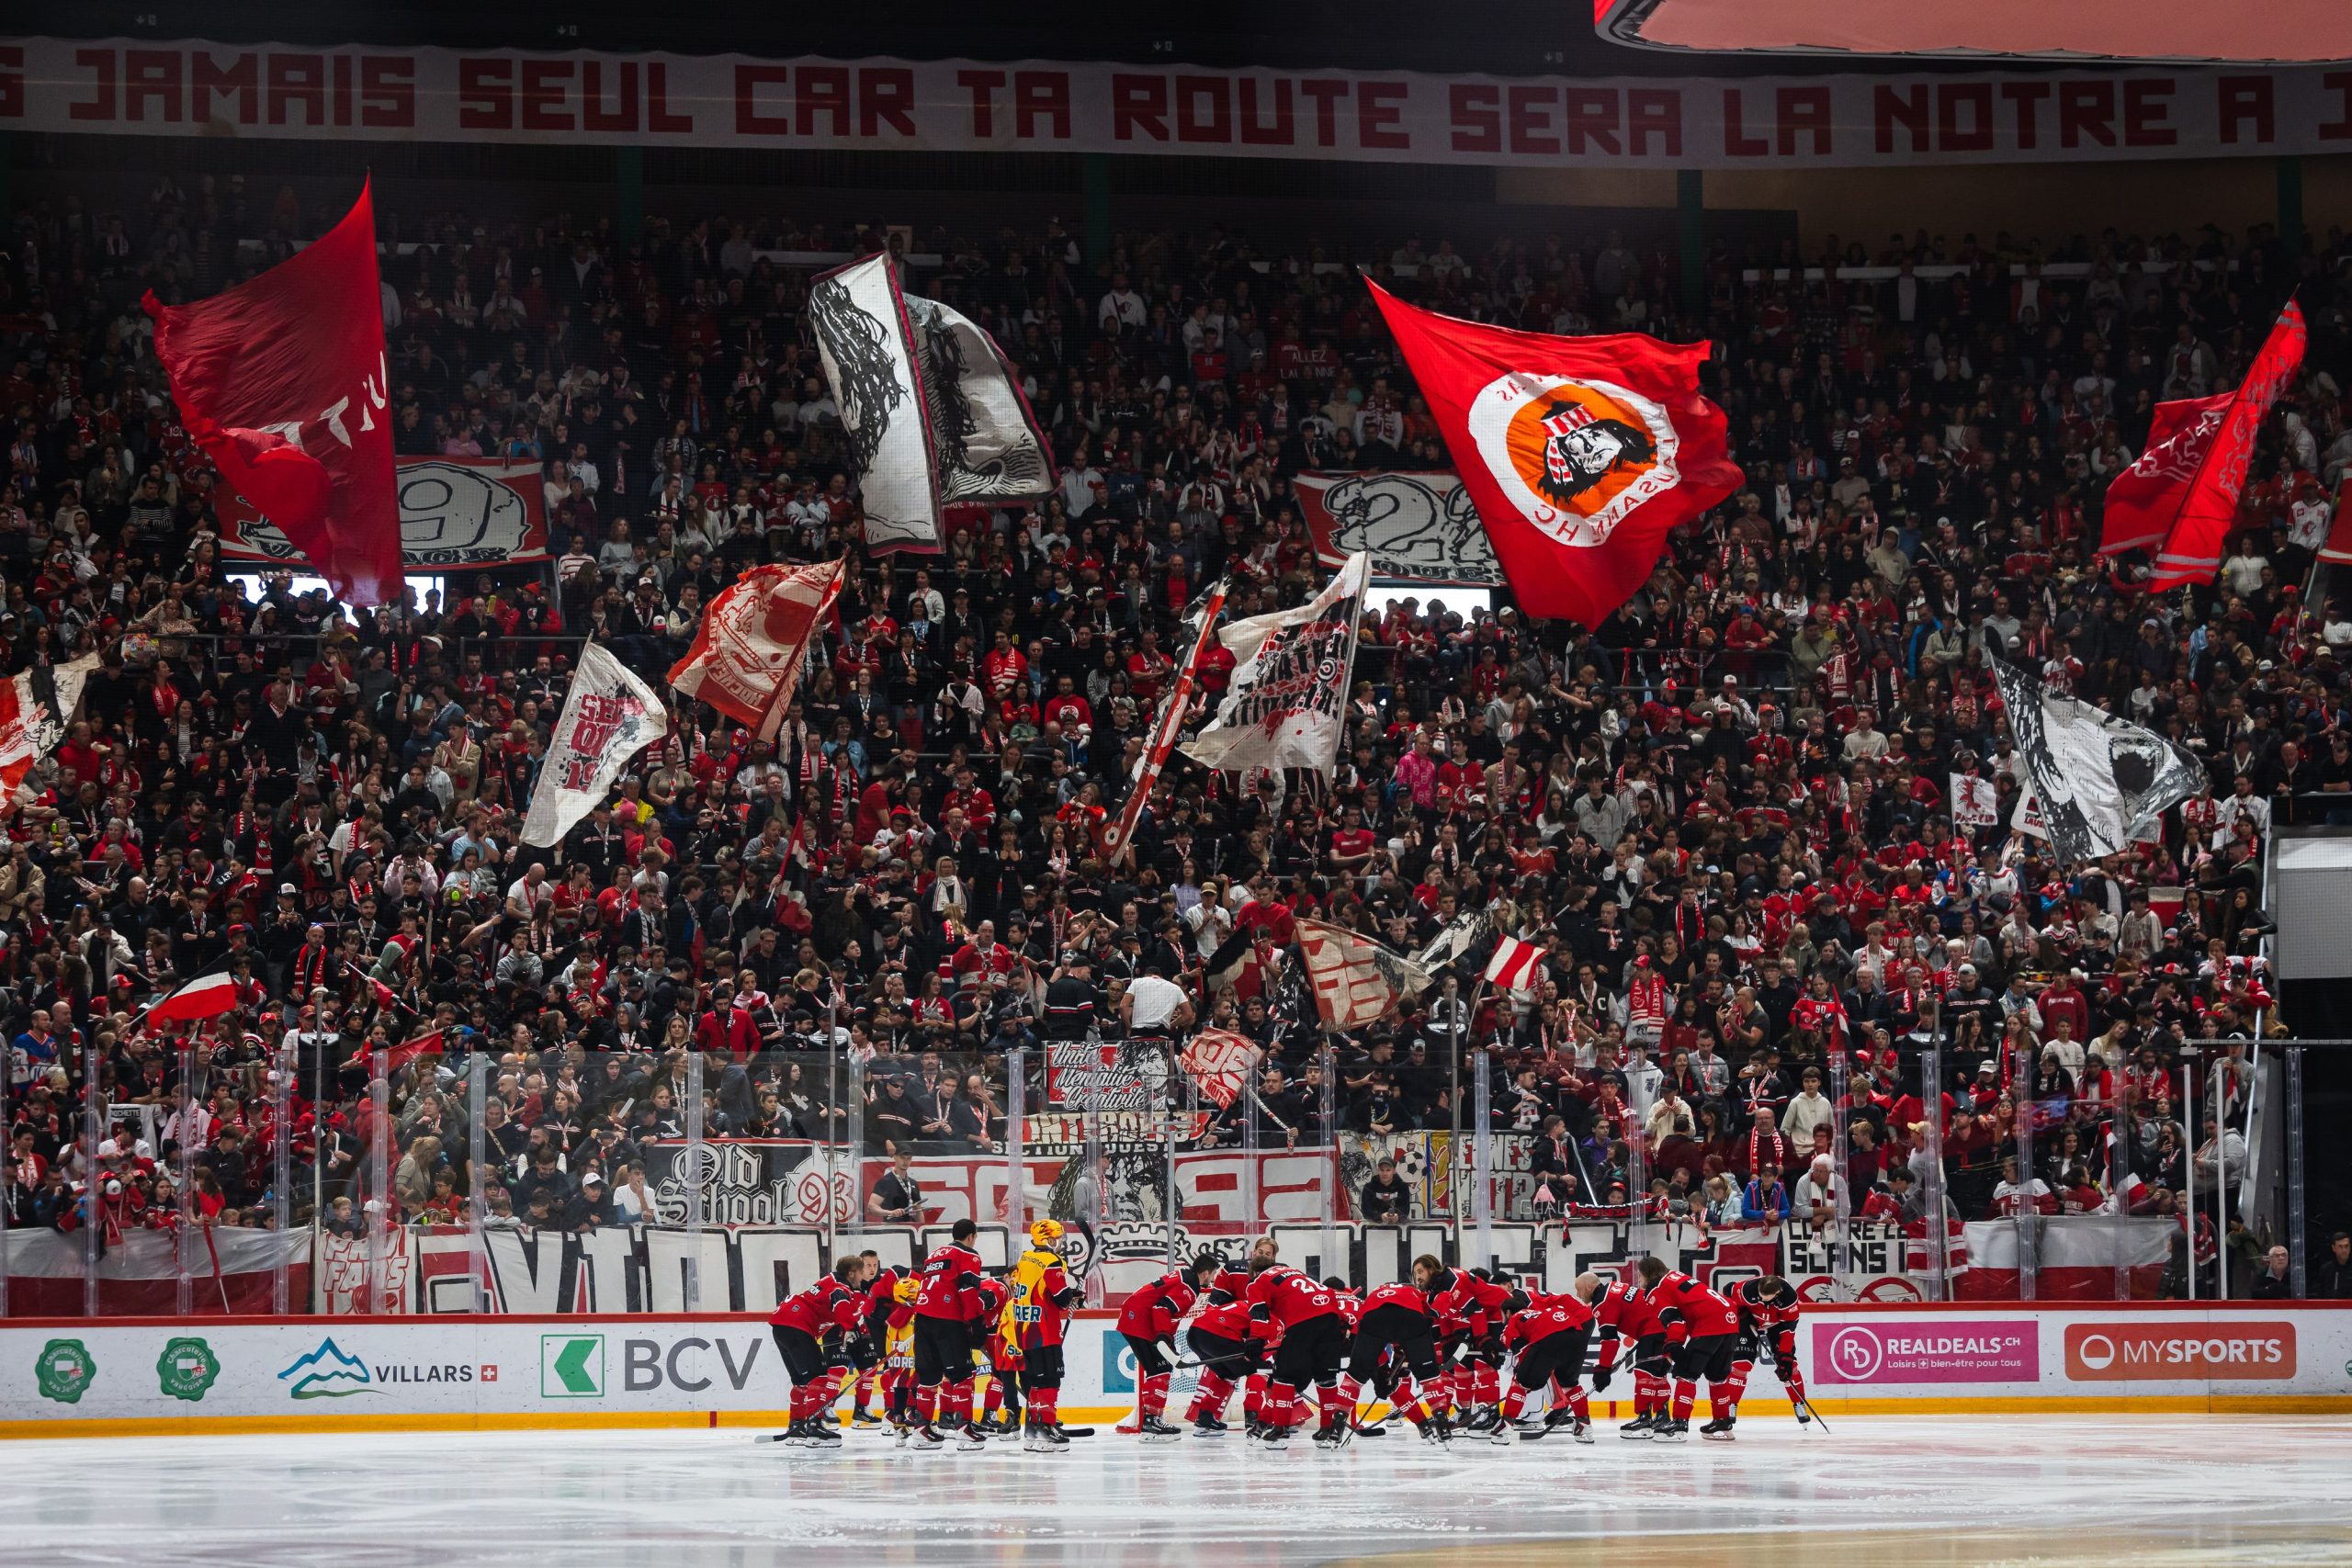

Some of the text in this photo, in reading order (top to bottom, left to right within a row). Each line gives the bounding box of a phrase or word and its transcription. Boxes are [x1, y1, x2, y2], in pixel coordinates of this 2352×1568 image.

[70, 49, 414, 127] JAMAIS
[459, 58, 693, 133] SEUL
[735, 64, 915, 137] CAR
[957, 70, 1070, 139] TA
[1113, 73, 1409, 149] ROUTE
[1450, 83, 1682, 157] SERA
[1724, 87, 1832, 157] LA
[1874, 78, 2177, 154] NOTRE
[2218, 75, 2275, 144] A
[1293, 350, 1327, 363] ALLEZ
[716, 765, 727, 776] 24
[1597, 997, 1607, 1010] C
[671, 1141, 762, 1192] Old
[655, 1178, 790, 1224] School
[1014, 1283, 1028, 1301] OP
[1013, 1304, 1043, 1324] RER
[2123, 1338, 2282, 1363] MYSPORTS
[624, 1337, 763, 1392] BCV
[888, 1356, 915, 1369] CORE
[1887, 1358, 2021, 1370] Loisirs bien-être pour tous
[376, 1365, 473, 1382] VILLARS
